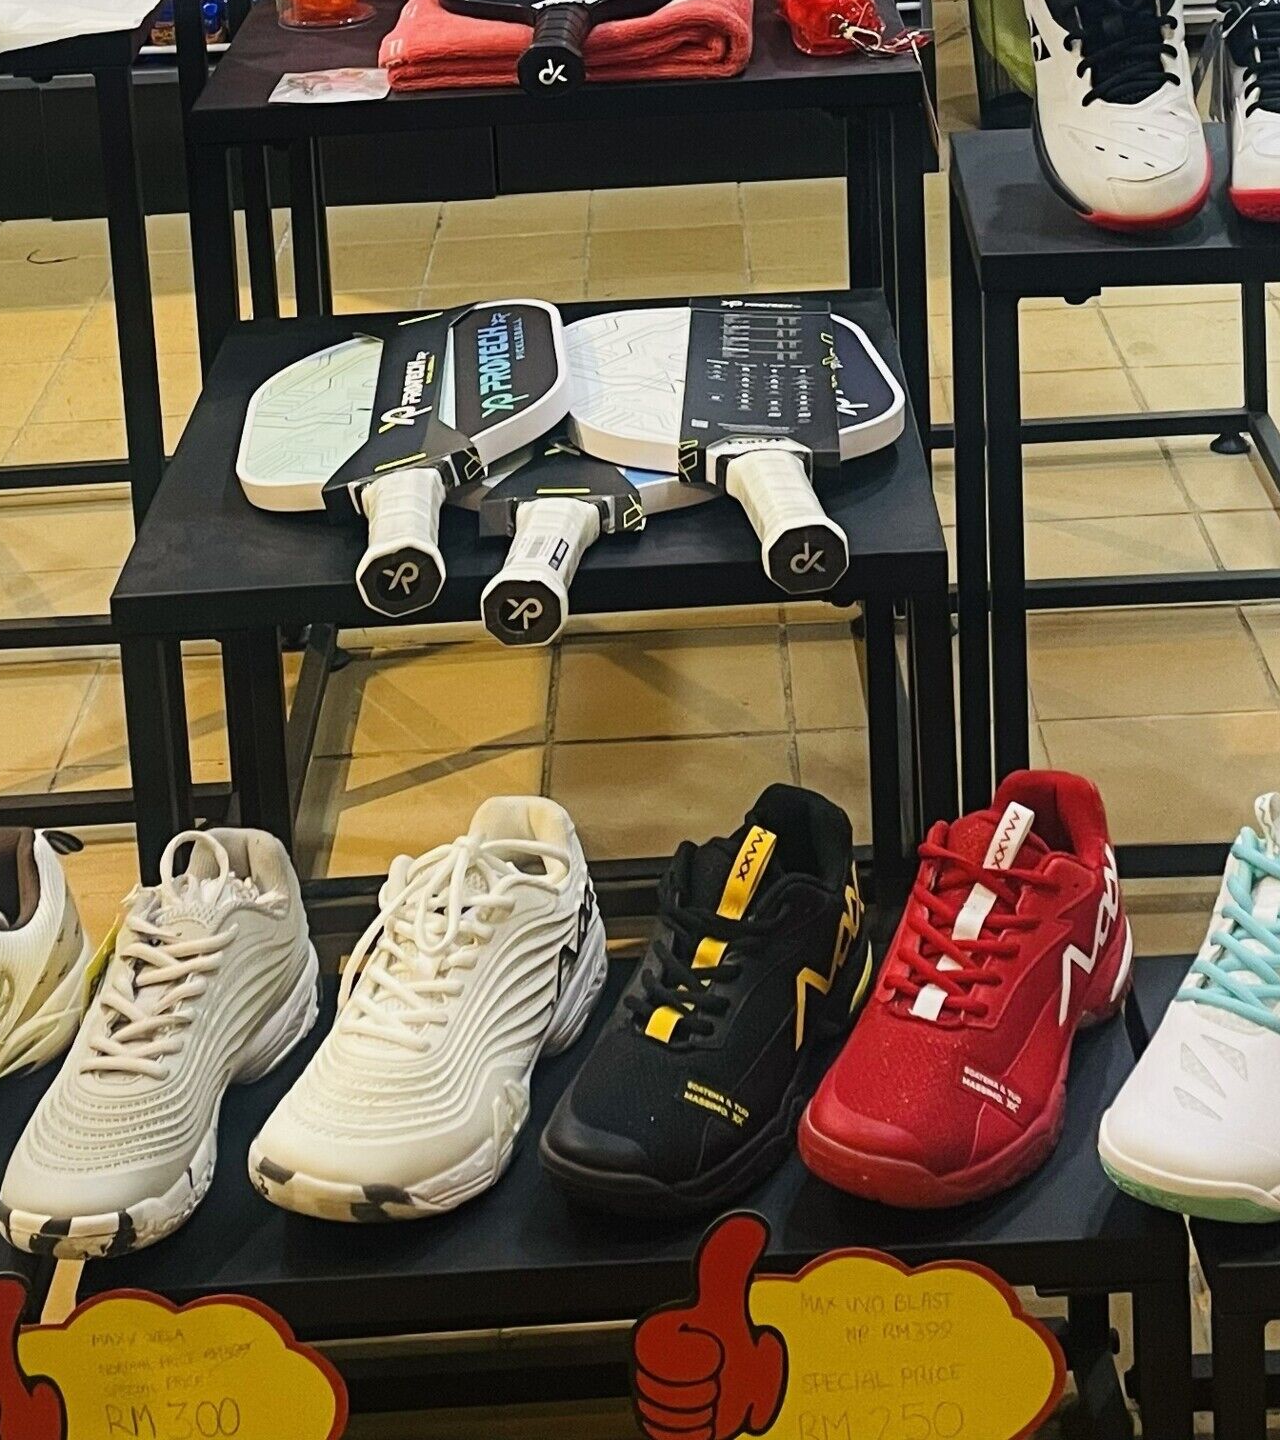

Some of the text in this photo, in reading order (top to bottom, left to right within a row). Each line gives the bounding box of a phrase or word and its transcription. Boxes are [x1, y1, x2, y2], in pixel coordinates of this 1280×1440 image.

[477, 325, 512, 395] PROTECH
[894, 1291, 953, 1313] BLAST
[801, 1363, 967, 1395] SPECIAL PRICE
[105, 1397, 241, 1440] RM 300
